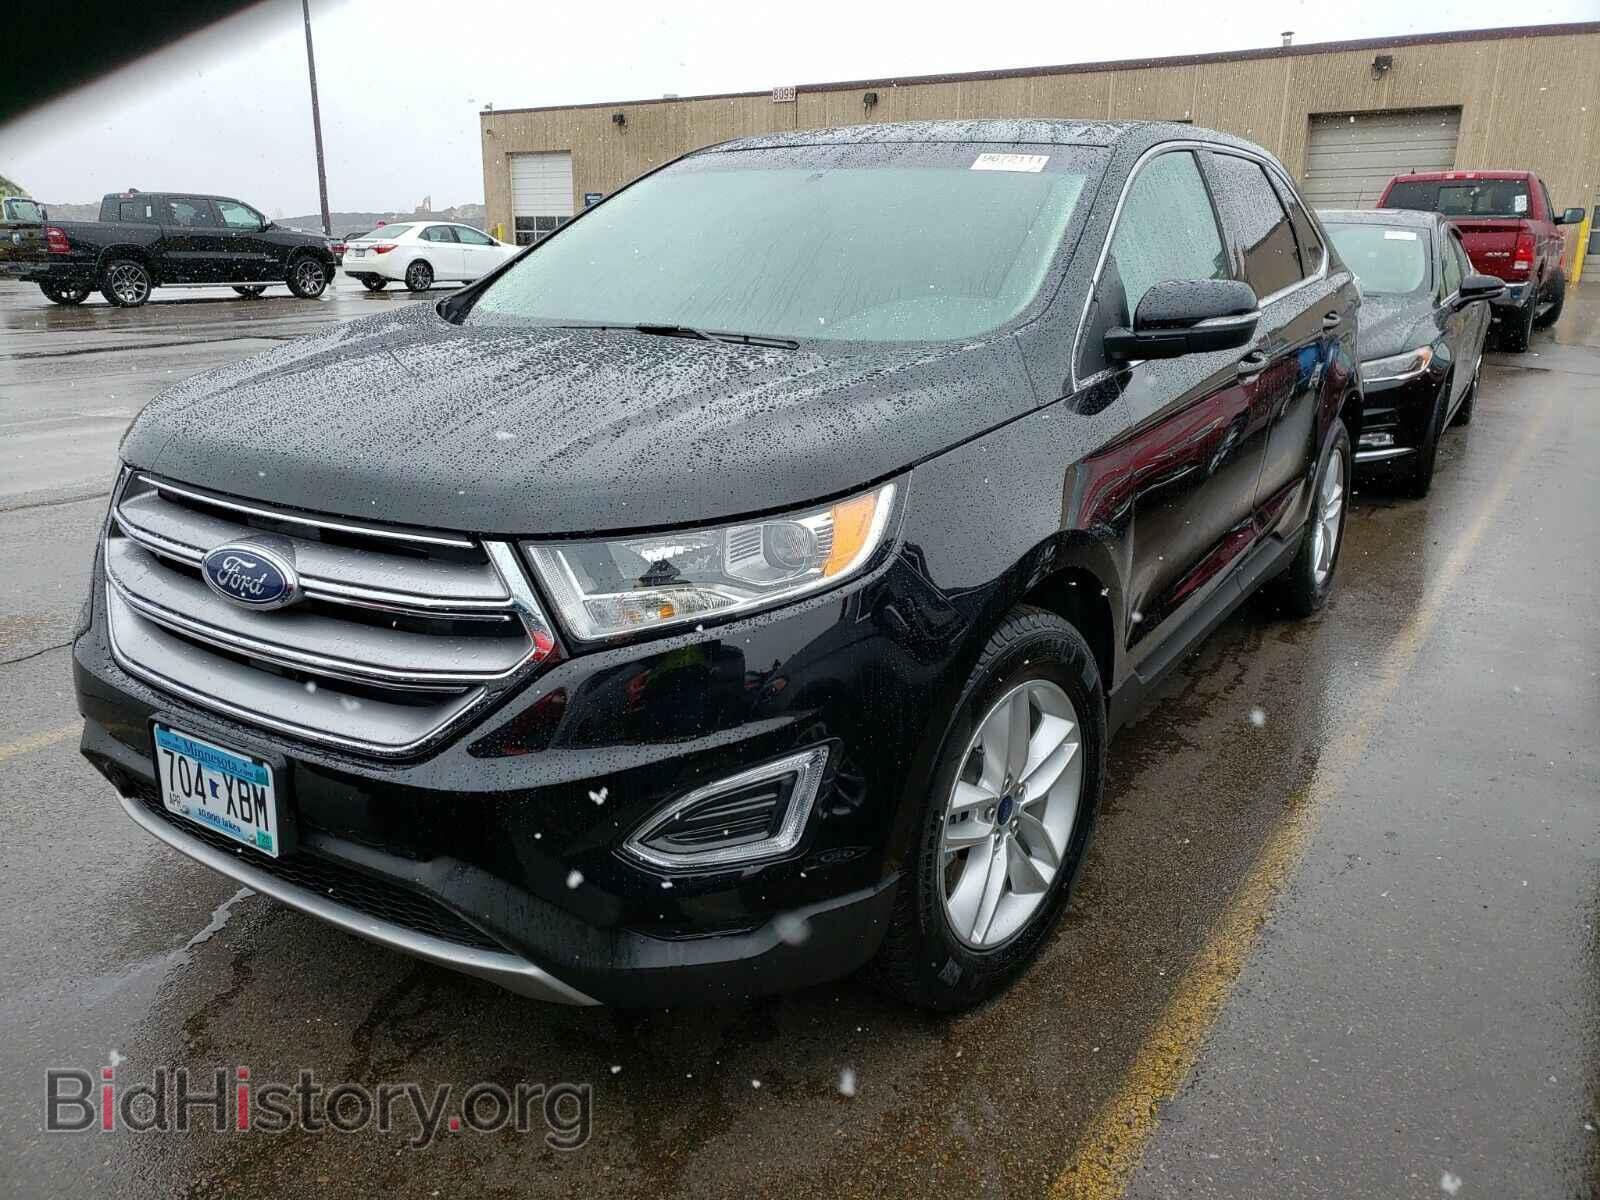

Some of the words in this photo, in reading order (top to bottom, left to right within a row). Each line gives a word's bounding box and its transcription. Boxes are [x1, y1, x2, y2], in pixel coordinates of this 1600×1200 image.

[773, 88, 795, 101] 8099
[217, 556, 268, 595] Ford
[163, 749, 206, 805] 704
[223, 771, 269, 832] XBM
